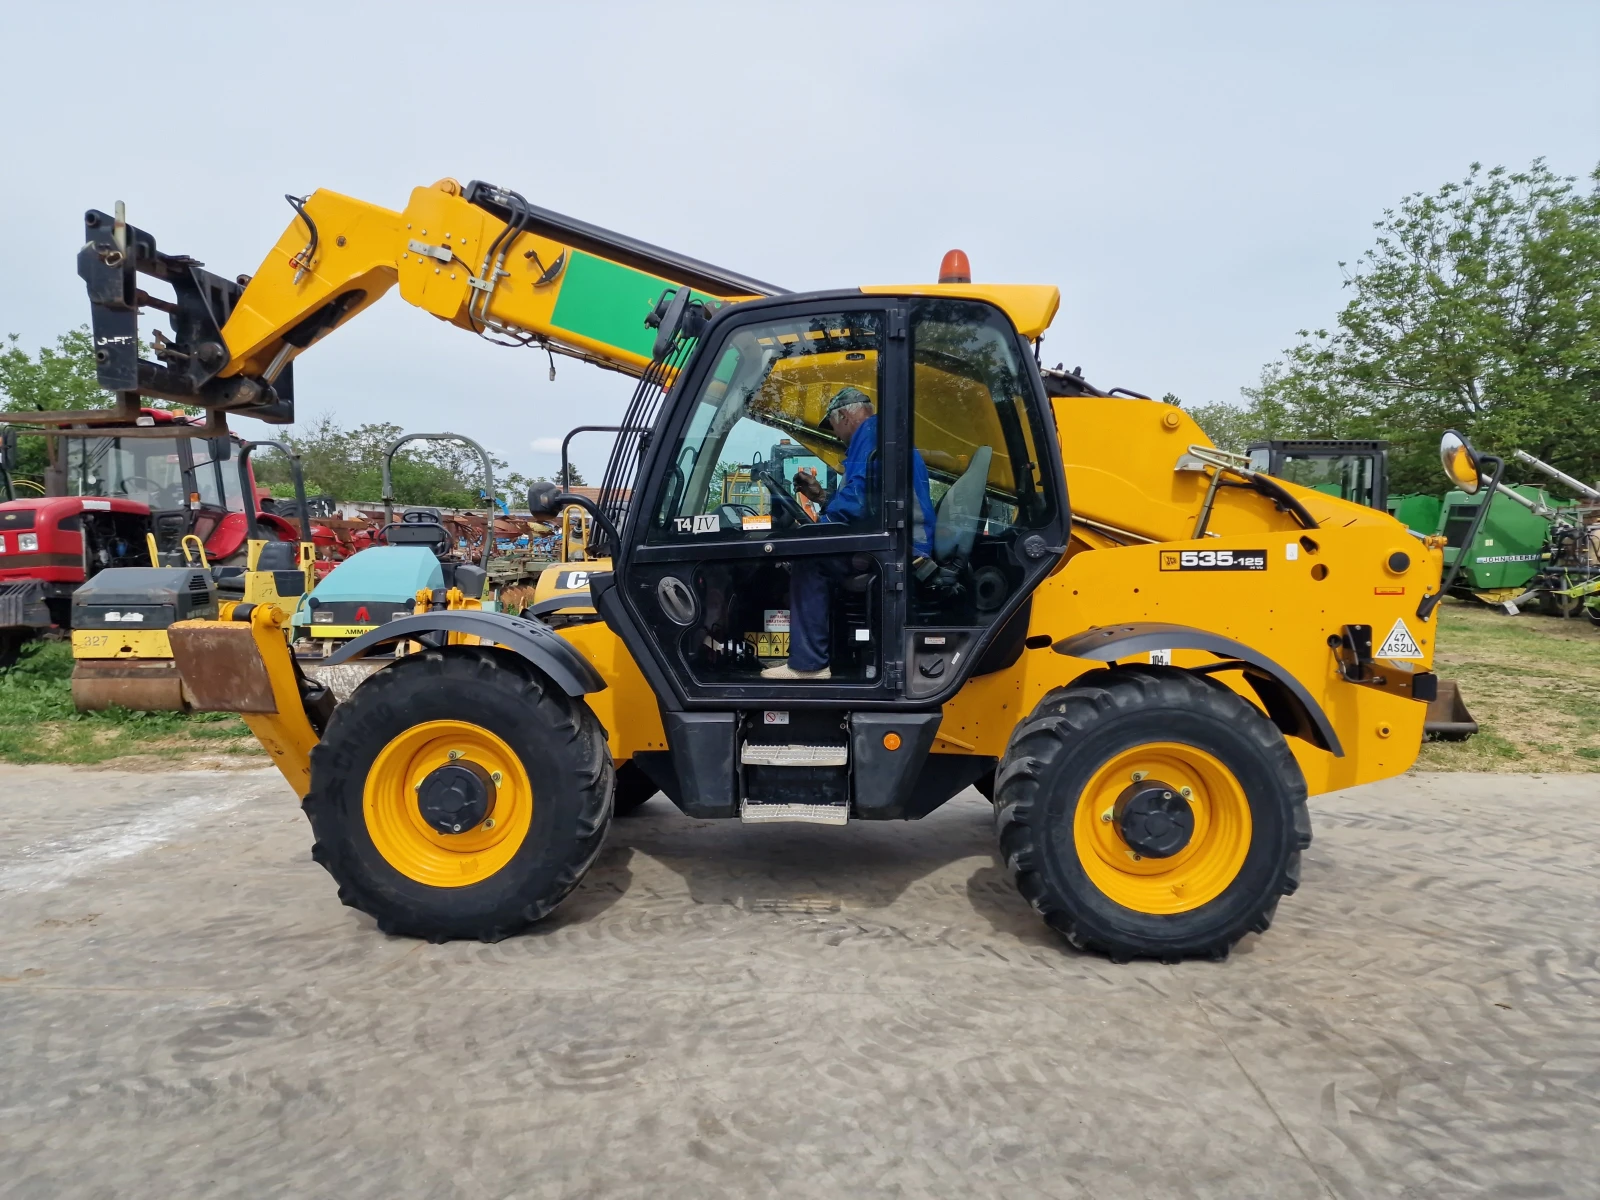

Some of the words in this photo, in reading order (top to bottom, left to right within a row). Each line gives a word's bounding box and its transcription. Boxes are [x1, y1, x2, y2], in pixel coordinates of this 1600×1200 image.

[674, 518, 692, 531] T4
[697, 517, 716, 531] IV
[1181, 551, 1264, 567] 535-125
[84, 636, 109, 647] 327
[1393, 633, 1406, 643] 47
[1387, 643, 1413, 653] AS2U
[1151, 655, 1164, 665] 104
